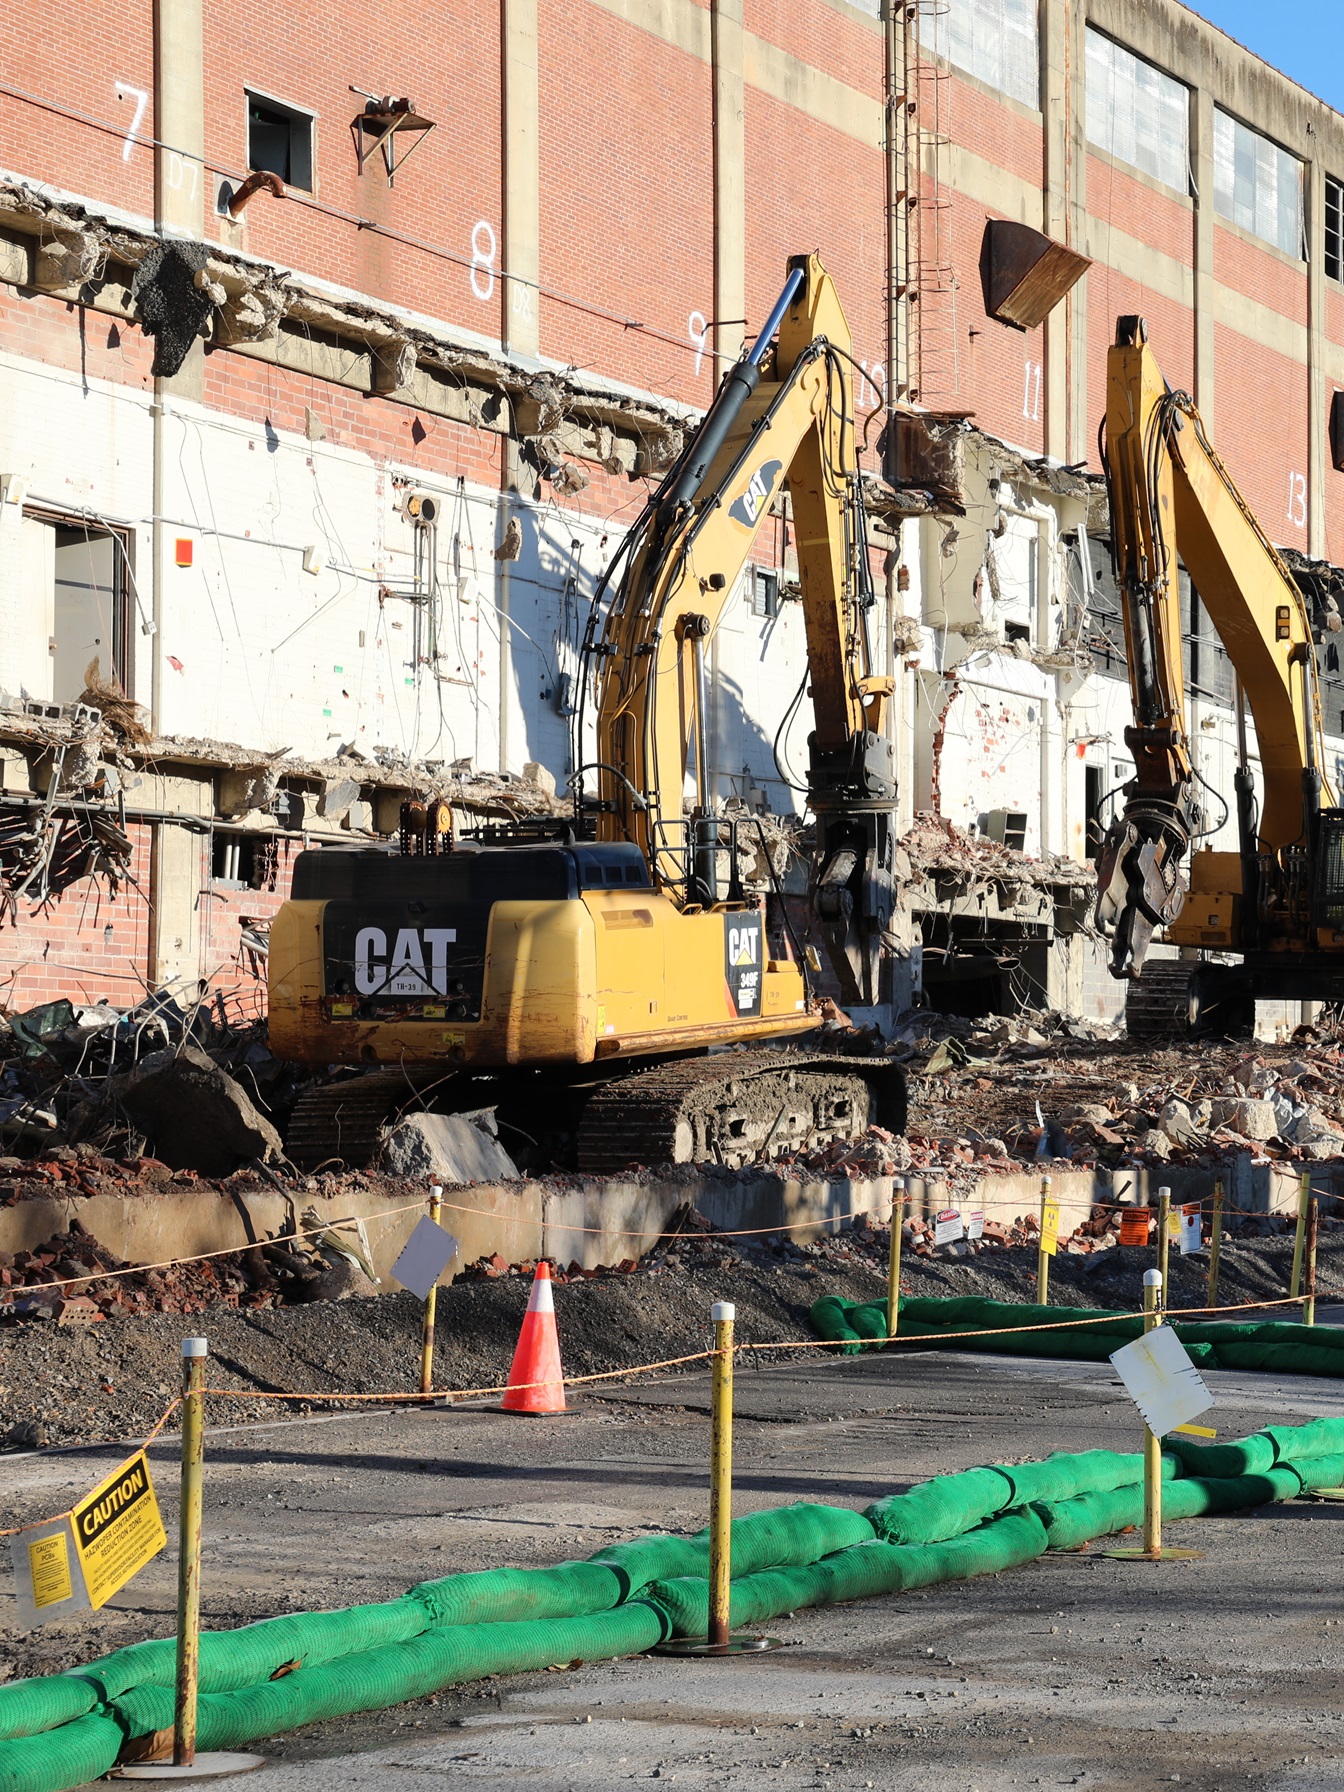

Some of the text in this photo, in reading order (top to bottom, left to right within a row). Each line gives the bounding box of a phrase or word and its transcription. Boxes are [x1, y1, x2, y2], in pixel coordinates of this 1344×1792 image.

[115, 80, 148, 161] 7
[168, 153, 198, 200] D7
[470, 221, 496, 300] 8
[512, 284, 531, 321] D8
[688, 311, 707, 376] 9
[1023, 361, 1041, 420] 11
[743, 469, 768, 522] CAT
[1287, 471, 1306, 527] 13
[355, 927, 457, 995] CAT
[729, 927, 758, 966] CAT
[396, 982, 417, 991] TH-39
[740, 972, 758, 988] 349F
[83, 1468, 144, 1536] CAUTION
[84, 1494, 151, 1560] HAZWOPER CONTAMINATION
[36, 1541, 59, 1554] CAUTION
[100, 1515, 142, 1558] REDUCTION ZONE
[91, 1578, 106, 1595] CONTACT
